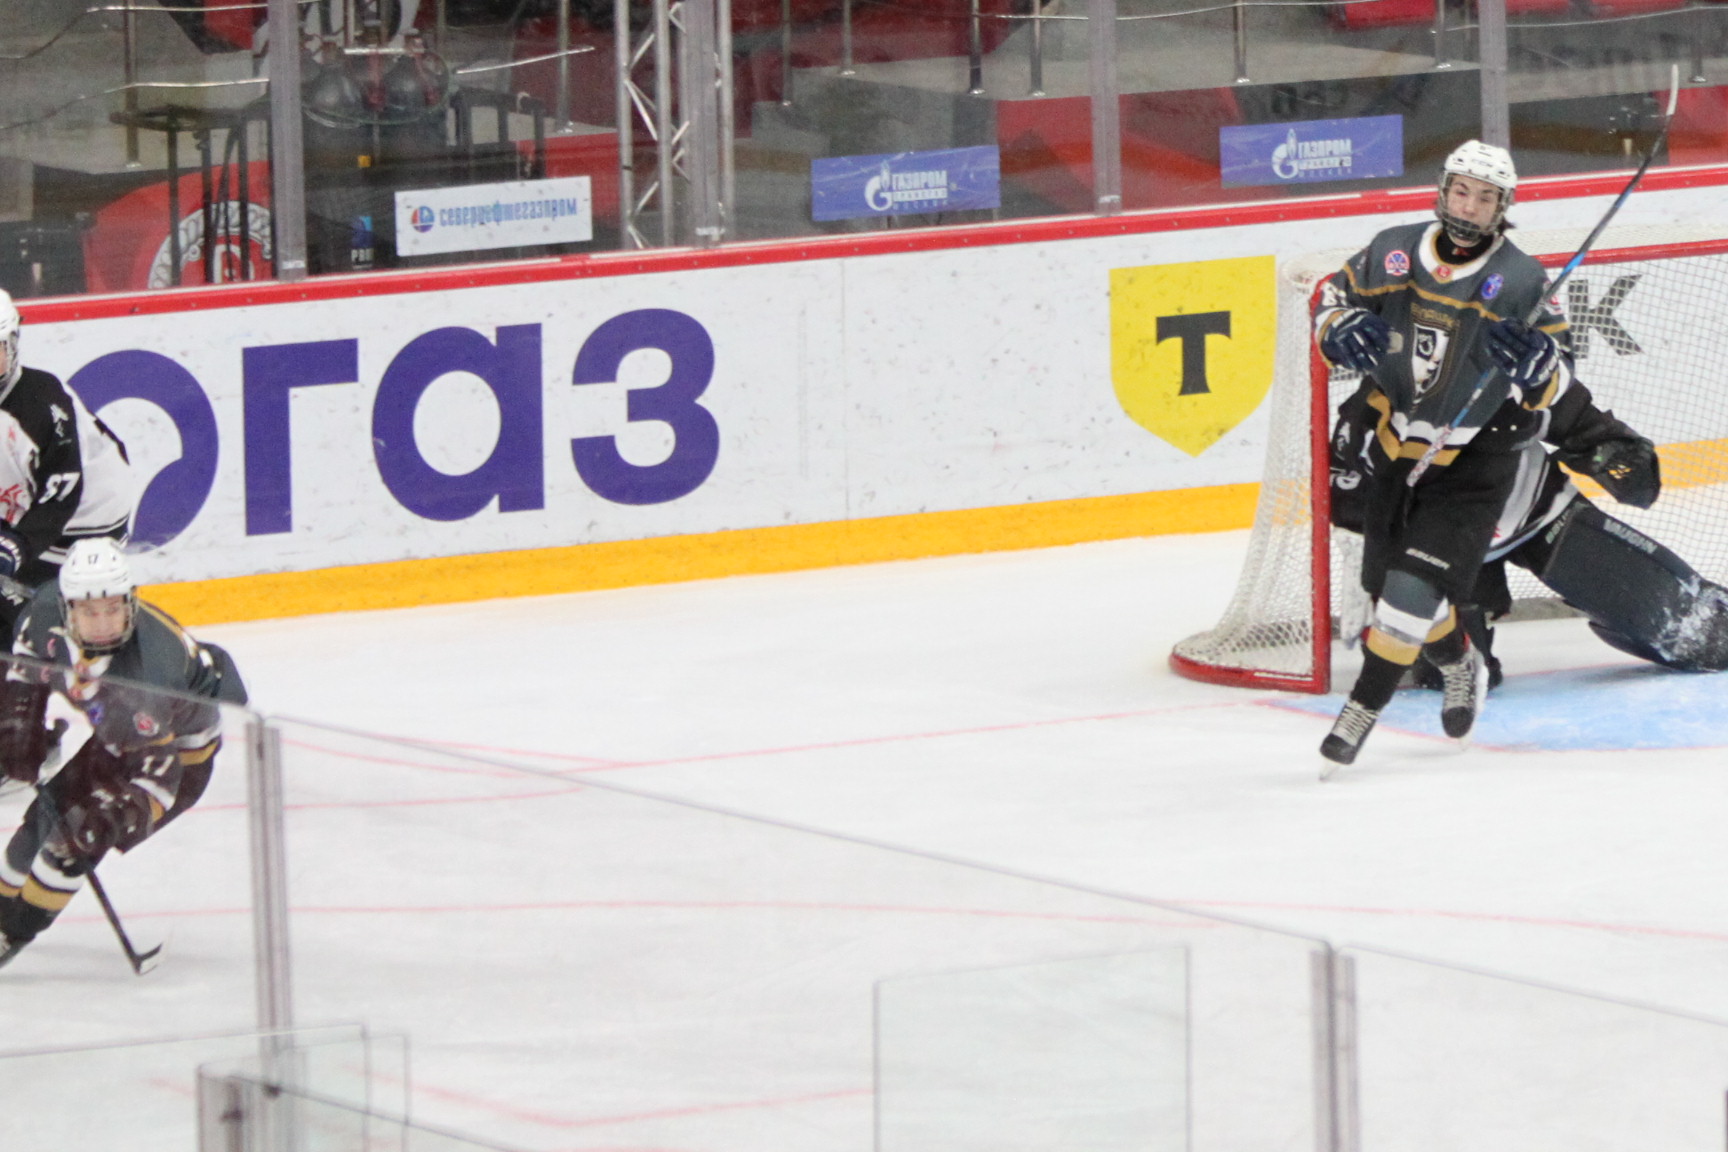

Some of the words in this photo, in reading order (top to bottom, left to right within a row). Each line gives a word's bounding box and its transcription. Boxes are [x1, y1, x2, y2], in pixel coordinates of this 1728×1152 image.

[1298, 138, 1352, 159] ГАЗПРОМ
[892, 169, 948, 191] ГАЗПРОМ
[1155, 309, 1232, 396] Т
[66, 307, 720, 555] огаз
[1602, 517, 1658, 555] VAUGHN
